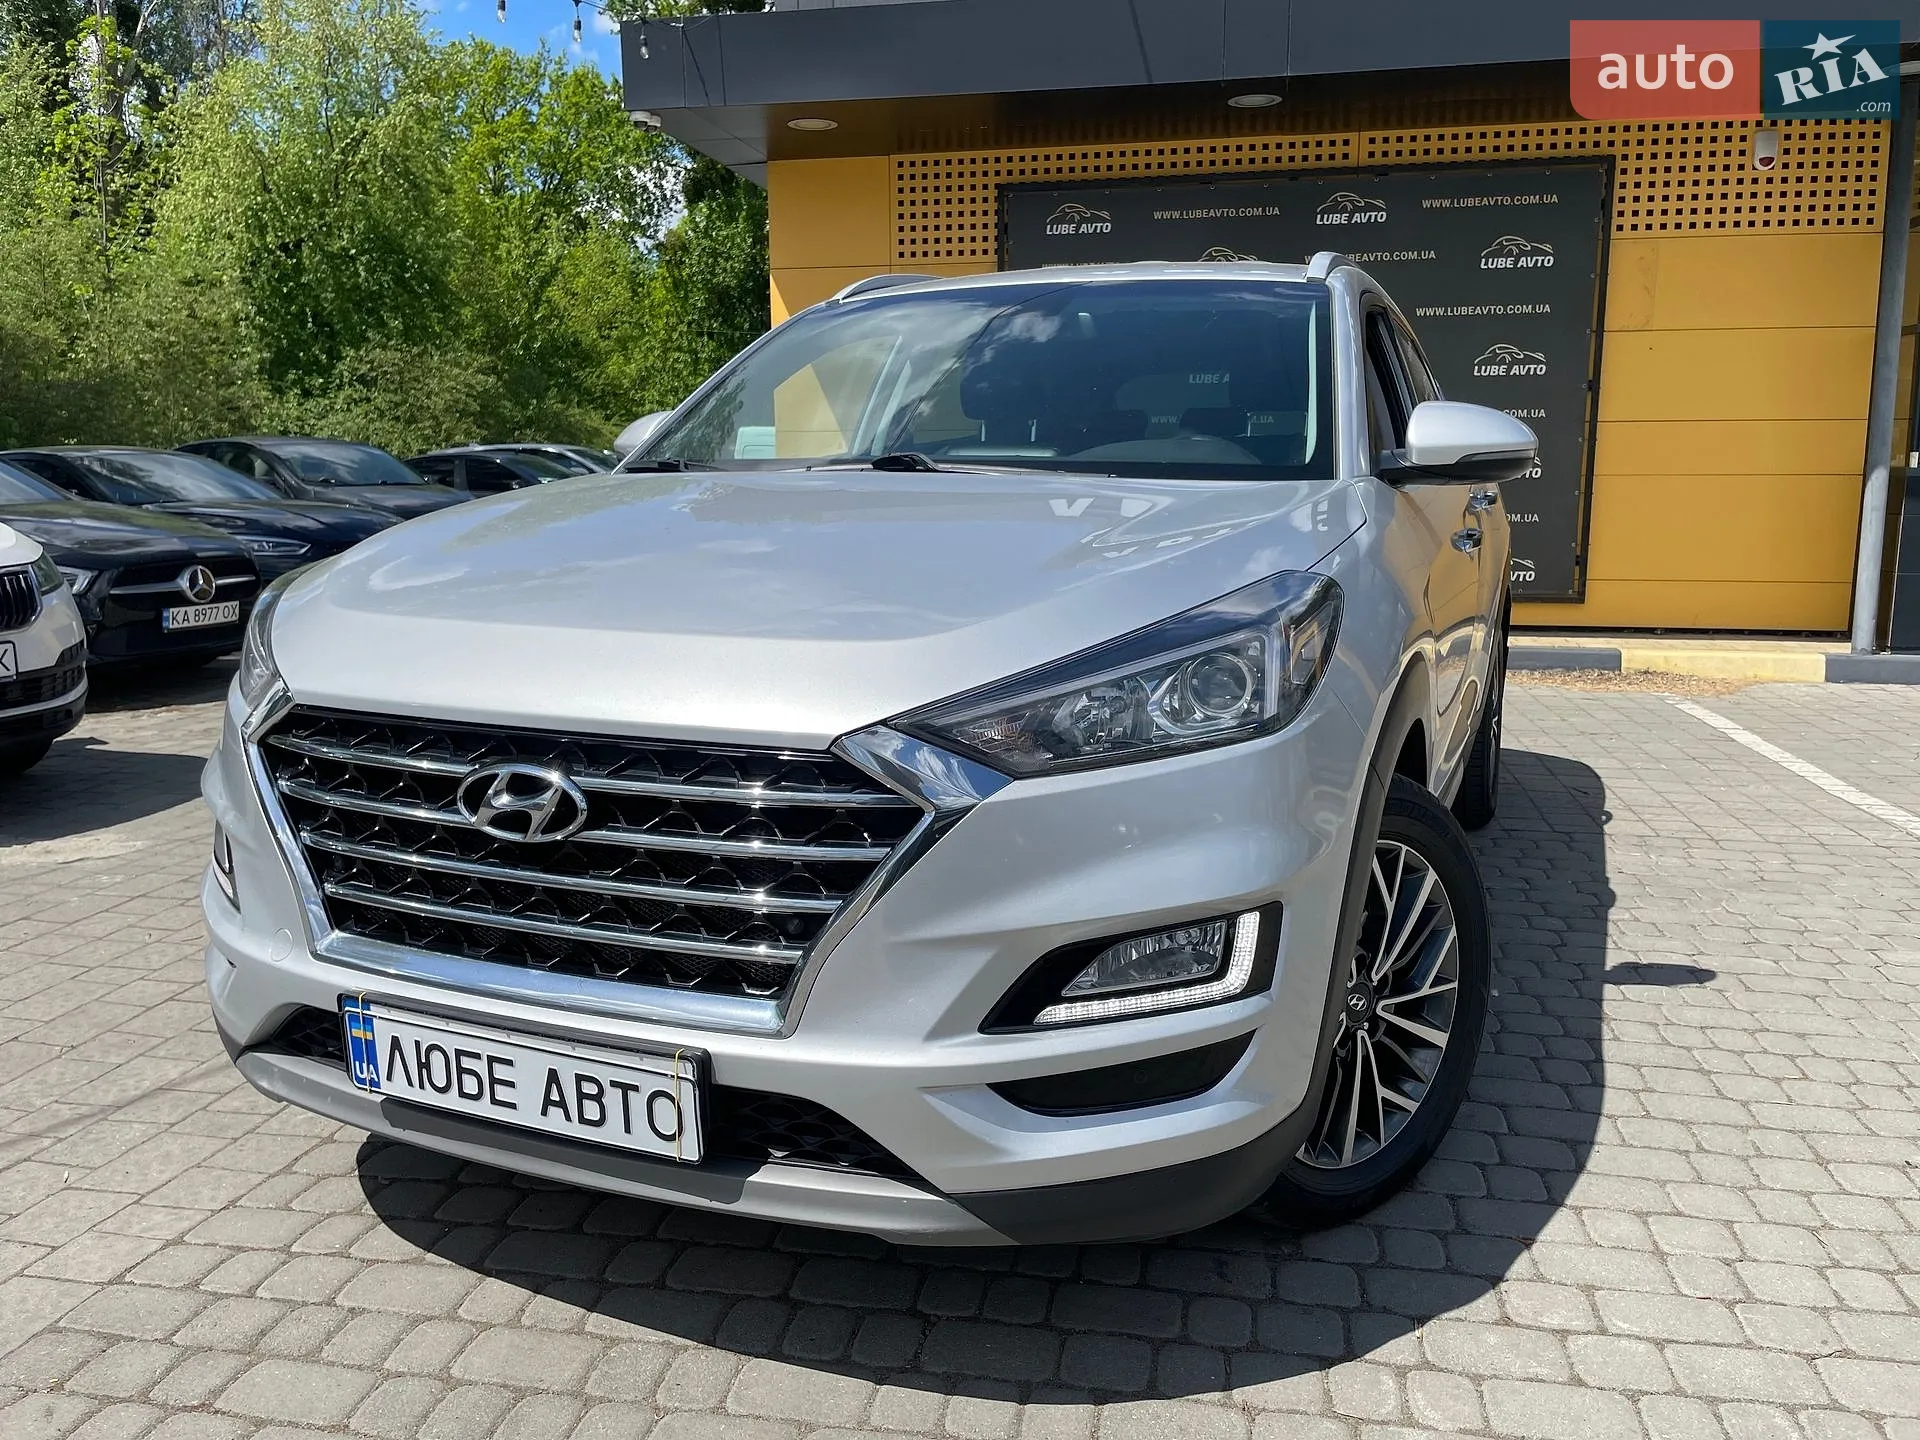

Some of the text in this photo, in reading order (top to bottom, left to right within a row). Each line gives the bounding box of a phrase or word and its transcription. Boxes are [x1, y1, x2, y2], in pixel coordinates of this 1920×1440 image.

[1421, 194, 1559, 208] WWW.LUBEAVTO.COM.UA
[1153, 207, 1281, 220] WWW.LUBEAVTO.COM.UA
[1316, 211, 1387, 225] LUBE AVTO
[1046, 222, 1112, 235] LUBE AVTO
[1480, 255, 1554, 269] LUBE AVTO
[1416, 304, 1551, 317] WWW.LUBEAVTO.COM.UA
[1473, 364, 1546, 377] LUBE AVTO
[1510, 570, 1535, 582] VTO
[194, 606, 220, 623] 8977
[355, 1060, 379, 1082] UA
[386, 1034, 684, 1142] ЛЮБЕ АВТО
